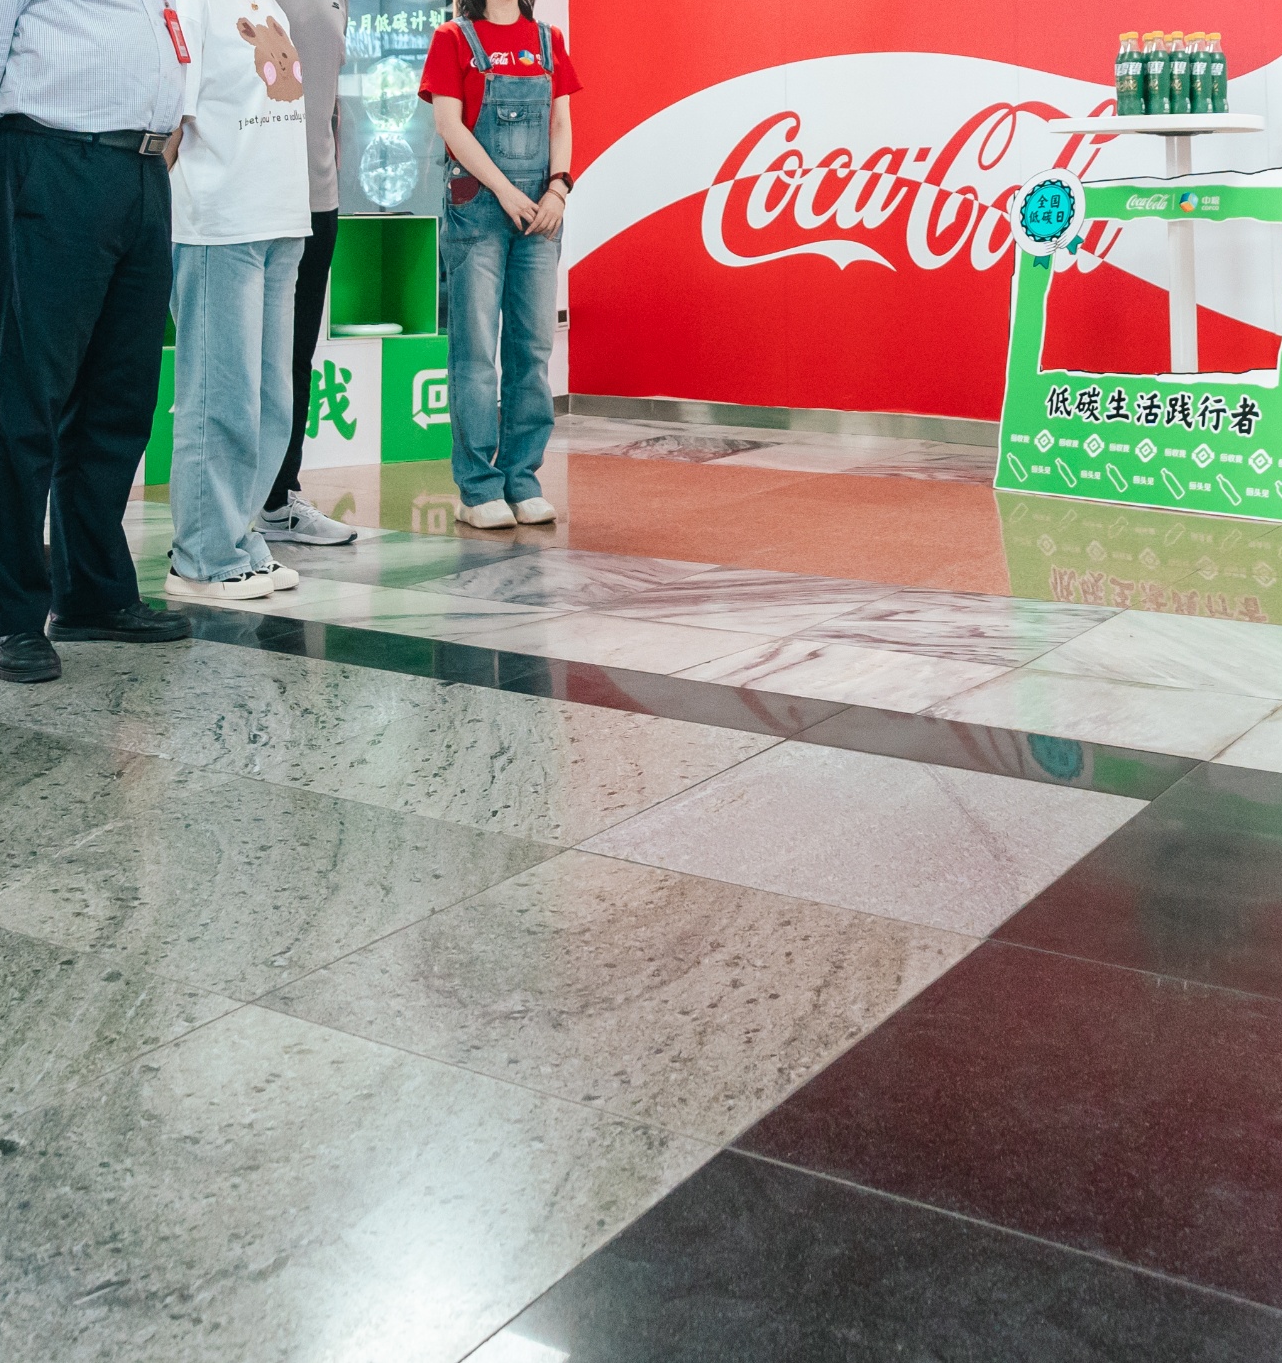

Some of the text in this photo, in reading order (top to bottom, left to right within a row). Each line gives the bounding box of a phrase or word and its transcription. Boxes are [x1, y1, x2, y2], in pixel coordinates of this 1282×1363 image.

[238, 119, 243, 131] I
[244, 114, 259, 127] bet
[1037, 194, 1061, 209] 全国
[1125, 193, 1171, 210] Coca-Cola
[1029, 209, 1065, 225] 低碳日
[1046, 386, 1260, 436] 低碳生活践行者
